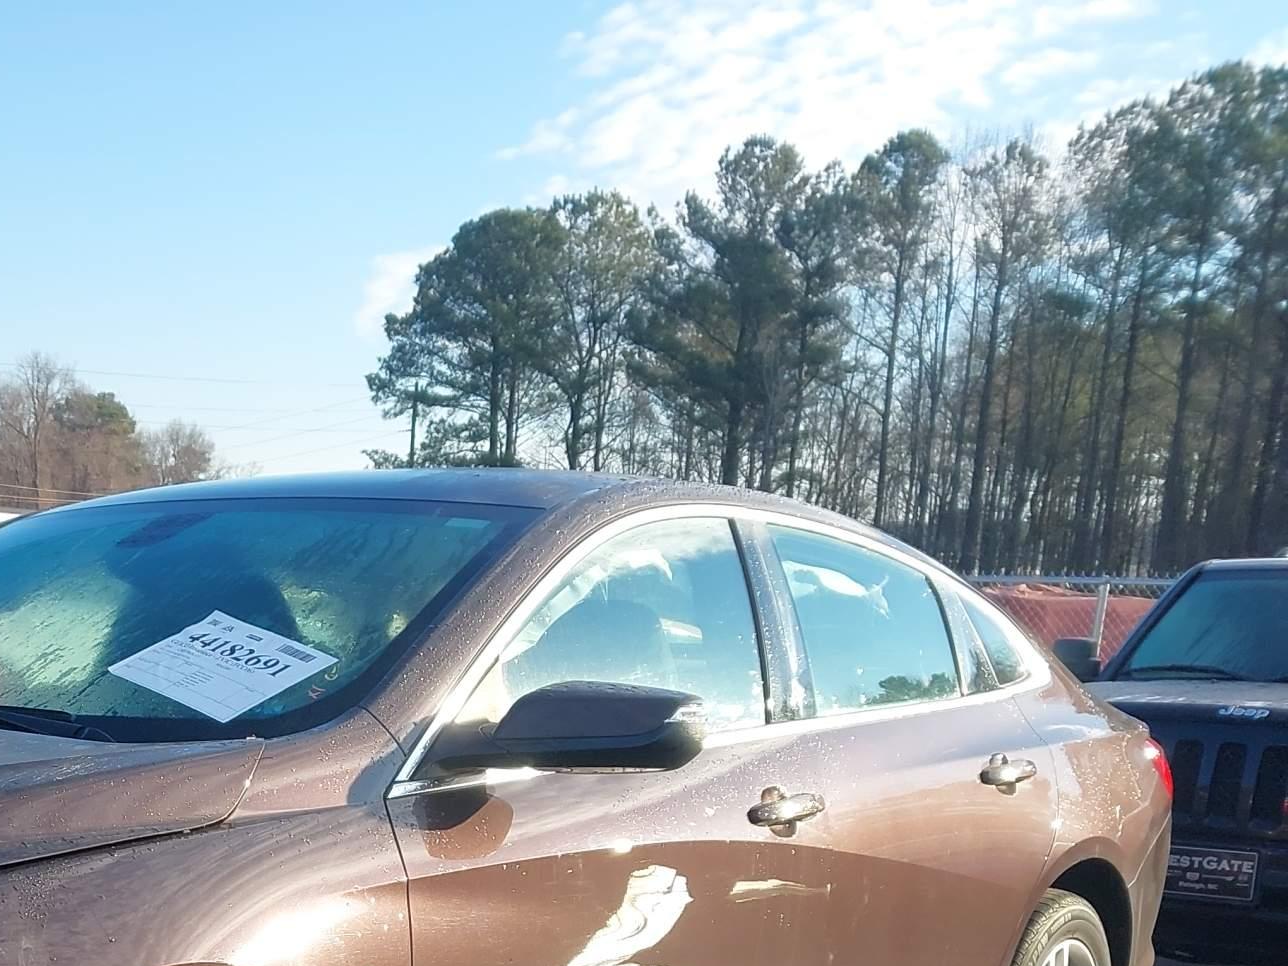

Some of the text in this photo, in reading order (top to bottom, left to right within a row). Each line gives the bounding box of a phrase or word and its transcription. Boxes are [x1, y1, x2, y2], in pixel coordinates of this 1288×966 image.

[188, 632, 291, 678] 44182691
[1218, 705, 1270, 719] Jeep
[1169, 854, 1254, 873] ESTGATE
